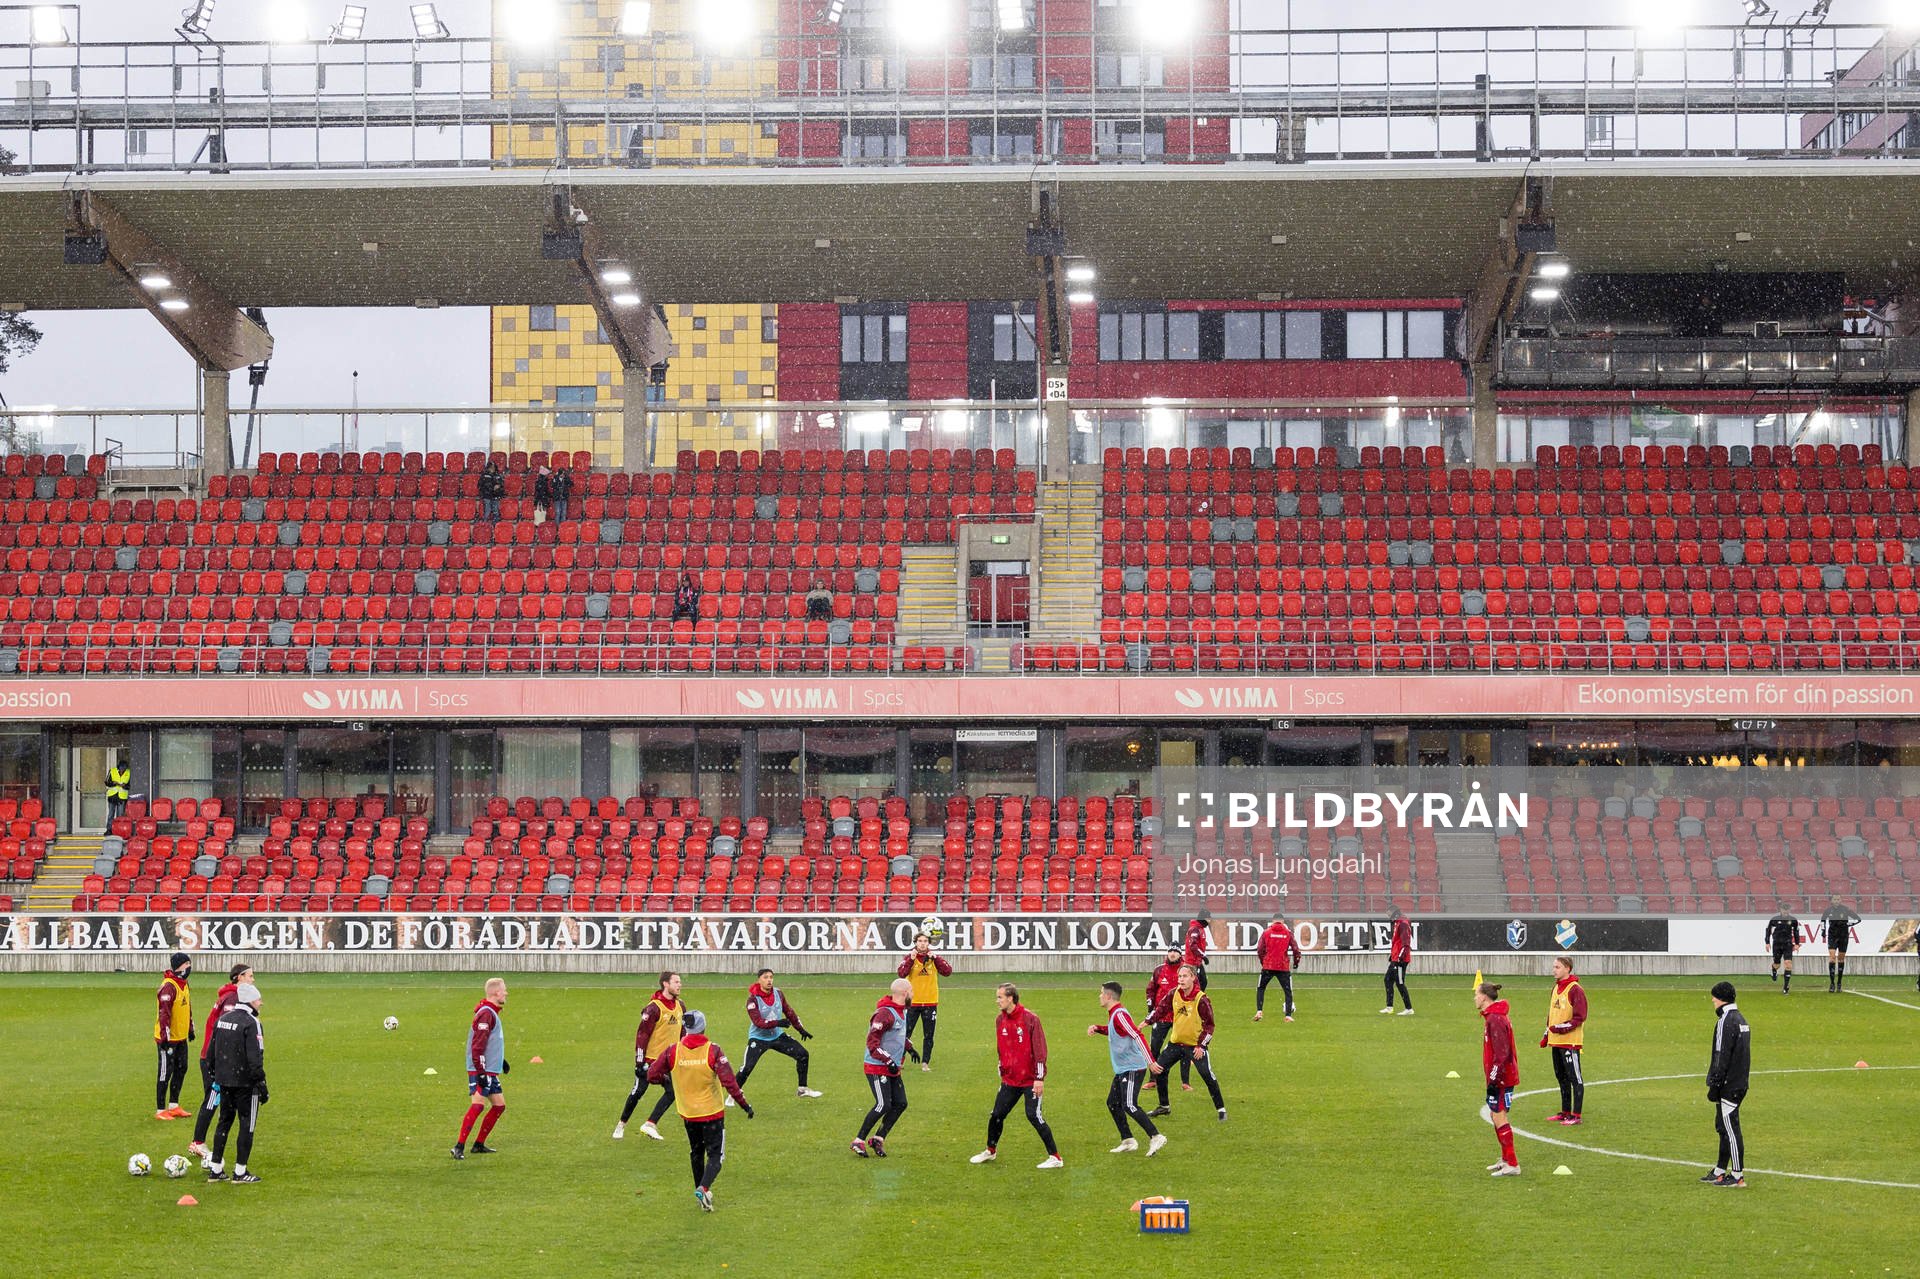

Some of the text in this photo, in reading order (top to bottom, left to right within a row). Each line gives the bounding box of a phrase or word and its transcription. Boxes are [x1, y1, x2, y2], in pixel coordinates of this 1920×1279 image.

[0, 687, 72, 707] passion
[336, 689, 469, 710] VISMA Spcs
[770, 688, 904, 709] VISMA Spcs
[1209, 687, 1345, 708] VISMA Spcs
[1578, 682, 1913, 708] Ekonomisystem för din passion
[353, 722, 364, 731] C5
[1278, 720, 1290, 729] C6
[1741, 720, 1768, 729] C7 F7
[0, 916, 170, 950] ÅLLBARA
[178, 921, 335, 950] SKOGEN,
[344, 921, 393, 950] DE
[401, 915, 625, 950] FÖRÄDLADE
[634, 916, 886, 950] TRÄVARORNA
[895, 921, 973, 950] OH
[982, 921, 1058, 950] DEN
[1226, 921, 1420, 950] IDOTTE
